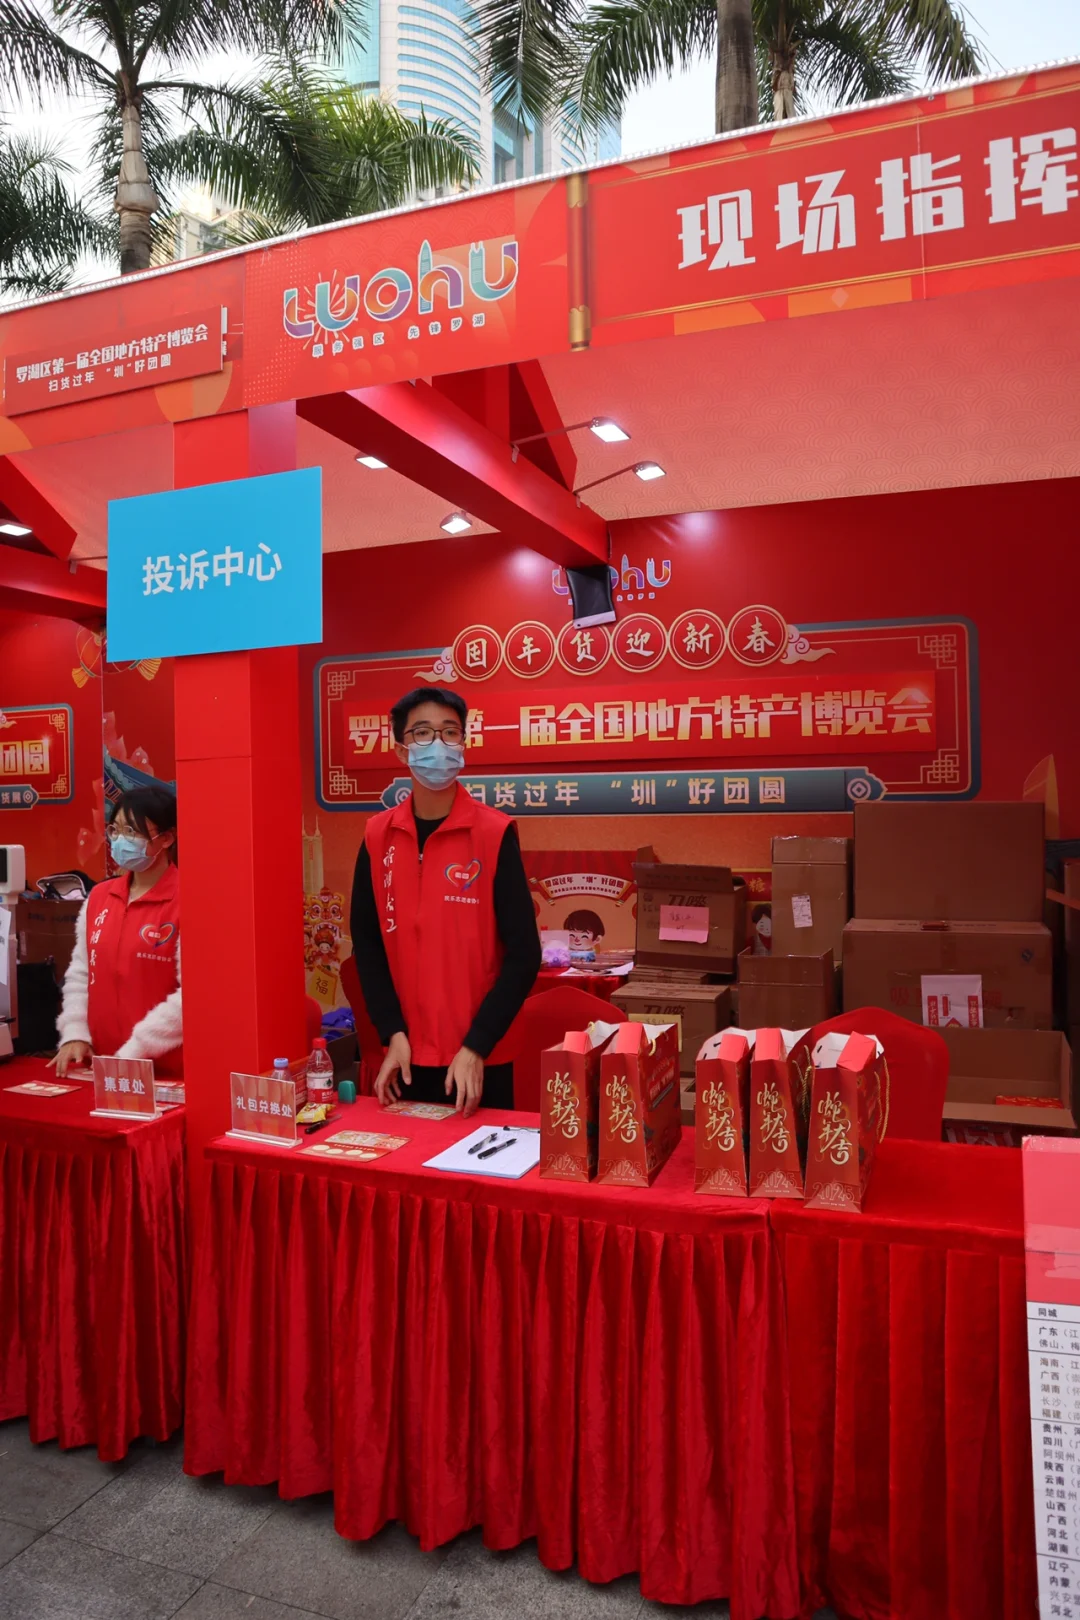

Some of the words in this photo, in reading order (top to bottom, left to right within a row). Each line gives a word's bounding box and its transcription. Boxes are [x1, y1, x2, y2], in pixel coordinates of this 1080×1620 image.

[676, 127, 1079, 271] 现场指挥
[16, 323, 209, 383] 罗湖区第一届全国地方特产博览会
[311, 332, 385, 358] 服务强区
[407, 312, 486, 339] 先锋罗湖
[48, 370, 95, 392] 扫货过年
[142, 542, 283, 596] 投诉中心
[464, 615, 776, 669] 囤年货迎新春
[348, 687, 933, 755] 罗第一届全国地方特产博览会
[0, 738, 51, 777] 团圆
[465, 780, 580, 809] 扫货过年
[315, 976, 329, 996] 福
[236, 1095, 293, 1118] 礼包兑换处
[546, 1071, 581, 1139] 蛇年大吉
[605, 1074, 640, 1144] 蛇年大吉
[702, 1081, 738, 1152] 蛇年大吉
[757, 1082, 790, 1154] 蛇年大吉
[817, 1091, 853, 1166] 蛇年大吉
[812, 1181, 854, 1202] 2025
[1038, 1307, 1057, 1318] 同城
